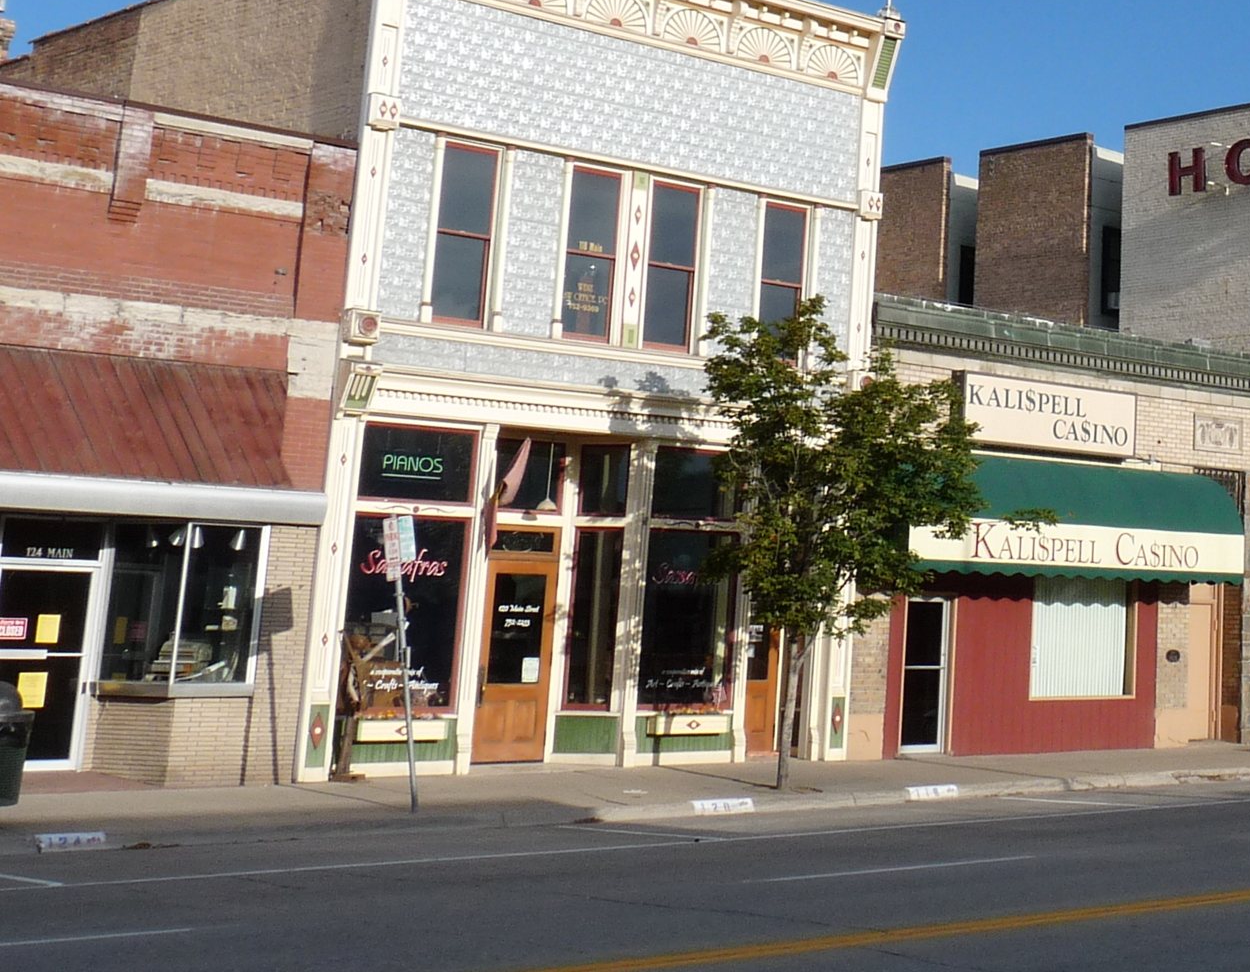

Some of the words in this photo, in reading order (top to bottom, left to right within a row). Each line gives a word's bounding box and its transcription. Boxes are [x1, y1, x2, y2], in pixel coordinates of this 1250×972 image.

[382, 454, 444, 474] PIANOS
[26, 547, 42, 557] 124
[47, 547, 74, 559] MAIN
[360, 548, 449, 583] Saafras
